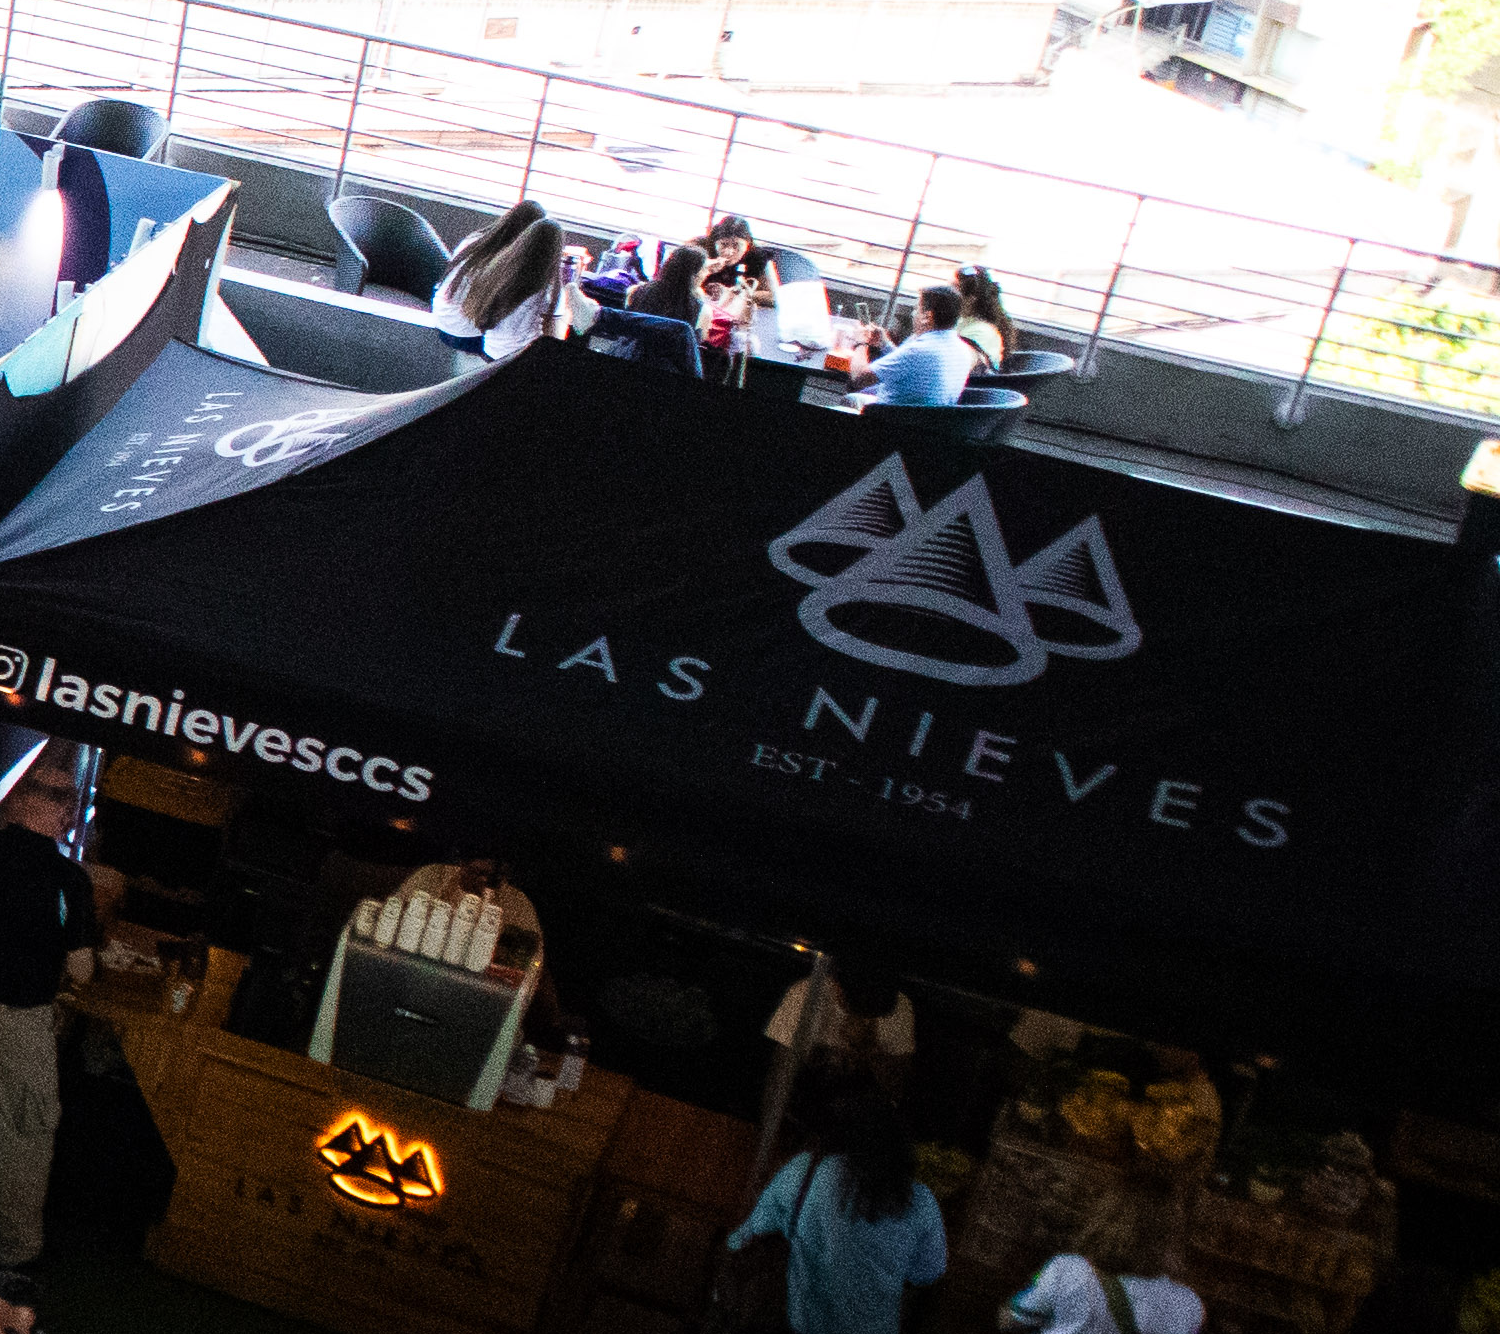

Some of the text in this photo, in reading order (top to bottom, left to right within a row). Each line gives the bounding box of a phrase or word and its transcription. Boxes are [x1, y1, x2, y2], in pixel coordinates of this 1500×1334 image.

[100, 392, 244, 513] LAS NIEVES
[35, 656, 434, 802] lasnievesccs
[494, 613, 1290, 849] LAS NIEVES
[751, 742, 837, 784] EST
[875, 775, 973, 822] 1954
